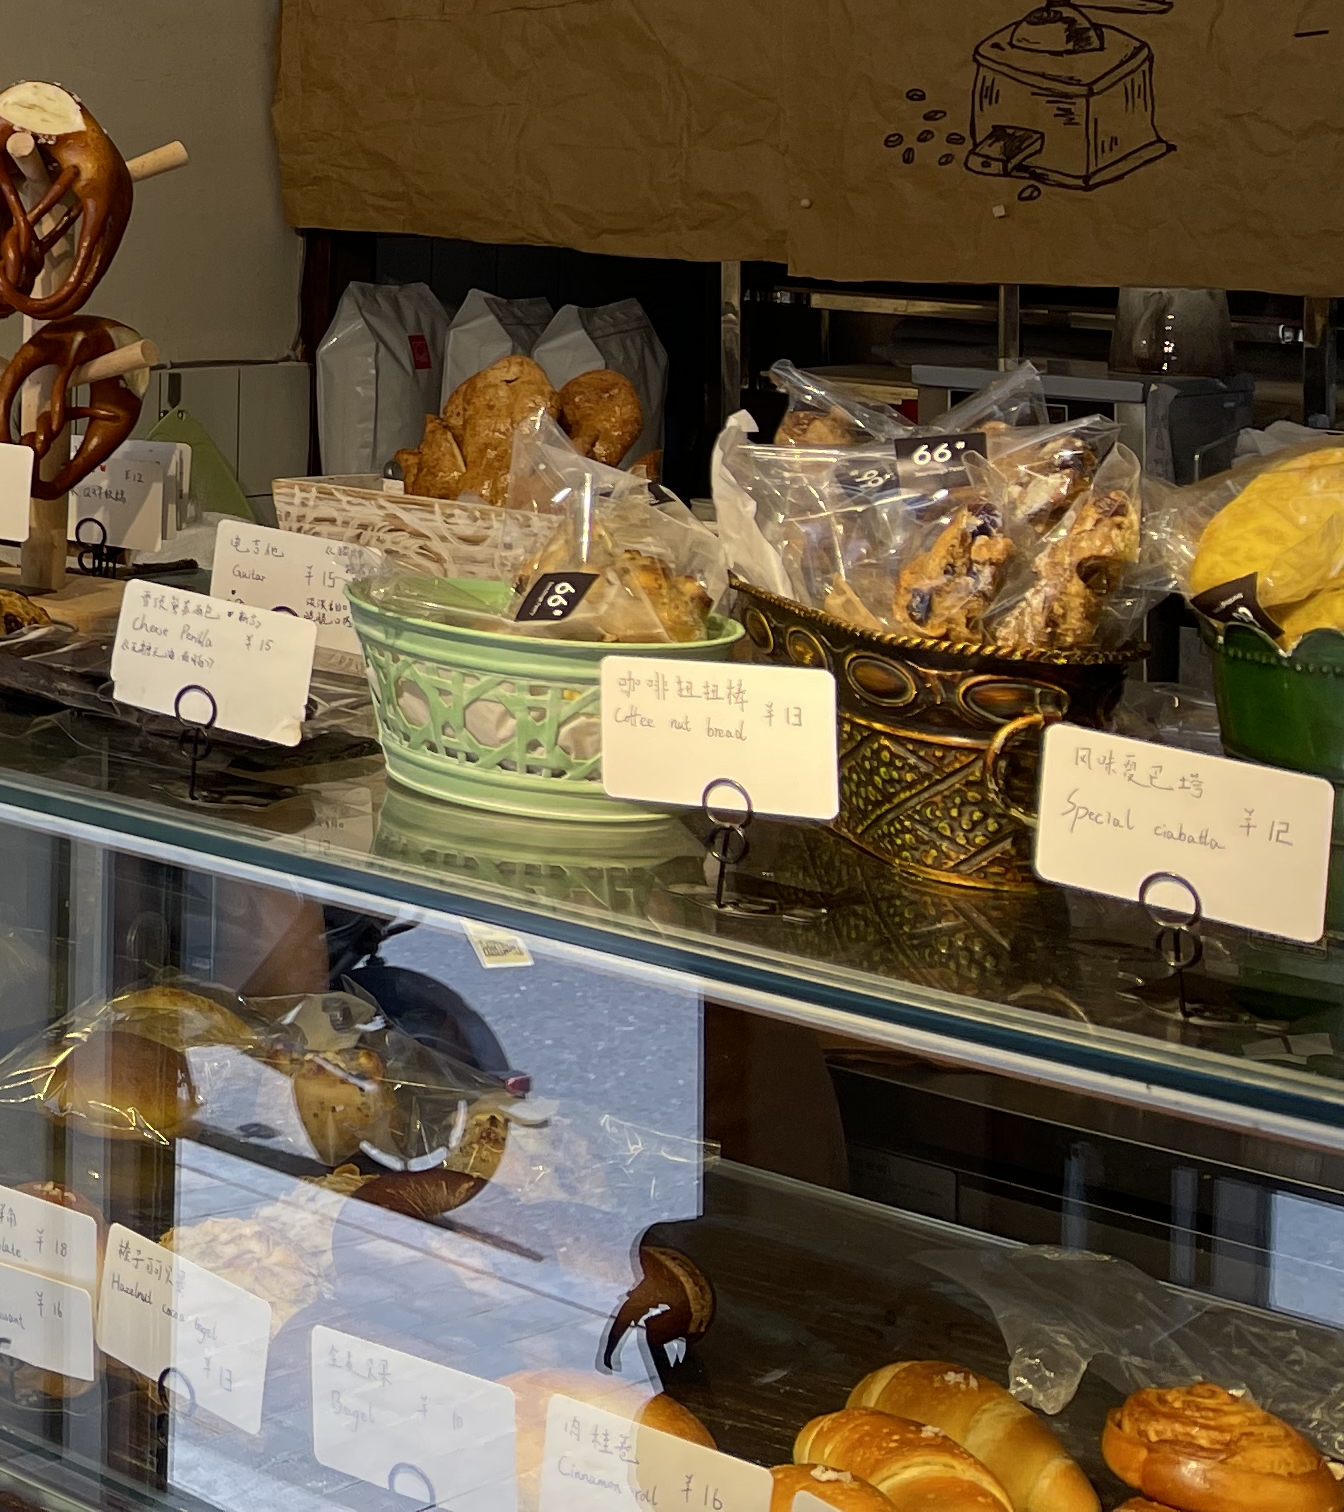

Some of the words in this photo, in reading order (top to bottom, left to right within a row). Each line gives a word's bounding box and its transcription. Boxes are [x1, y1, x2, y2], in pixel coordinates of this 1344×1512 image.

[613, 706, 656, 730] Coffee
[669, 717, 692, 733] nut
[706, 718, 748, 742] bread
[1059, 789, 1135, 834] Special
[330, 1389, 376, 1433] Bagel
